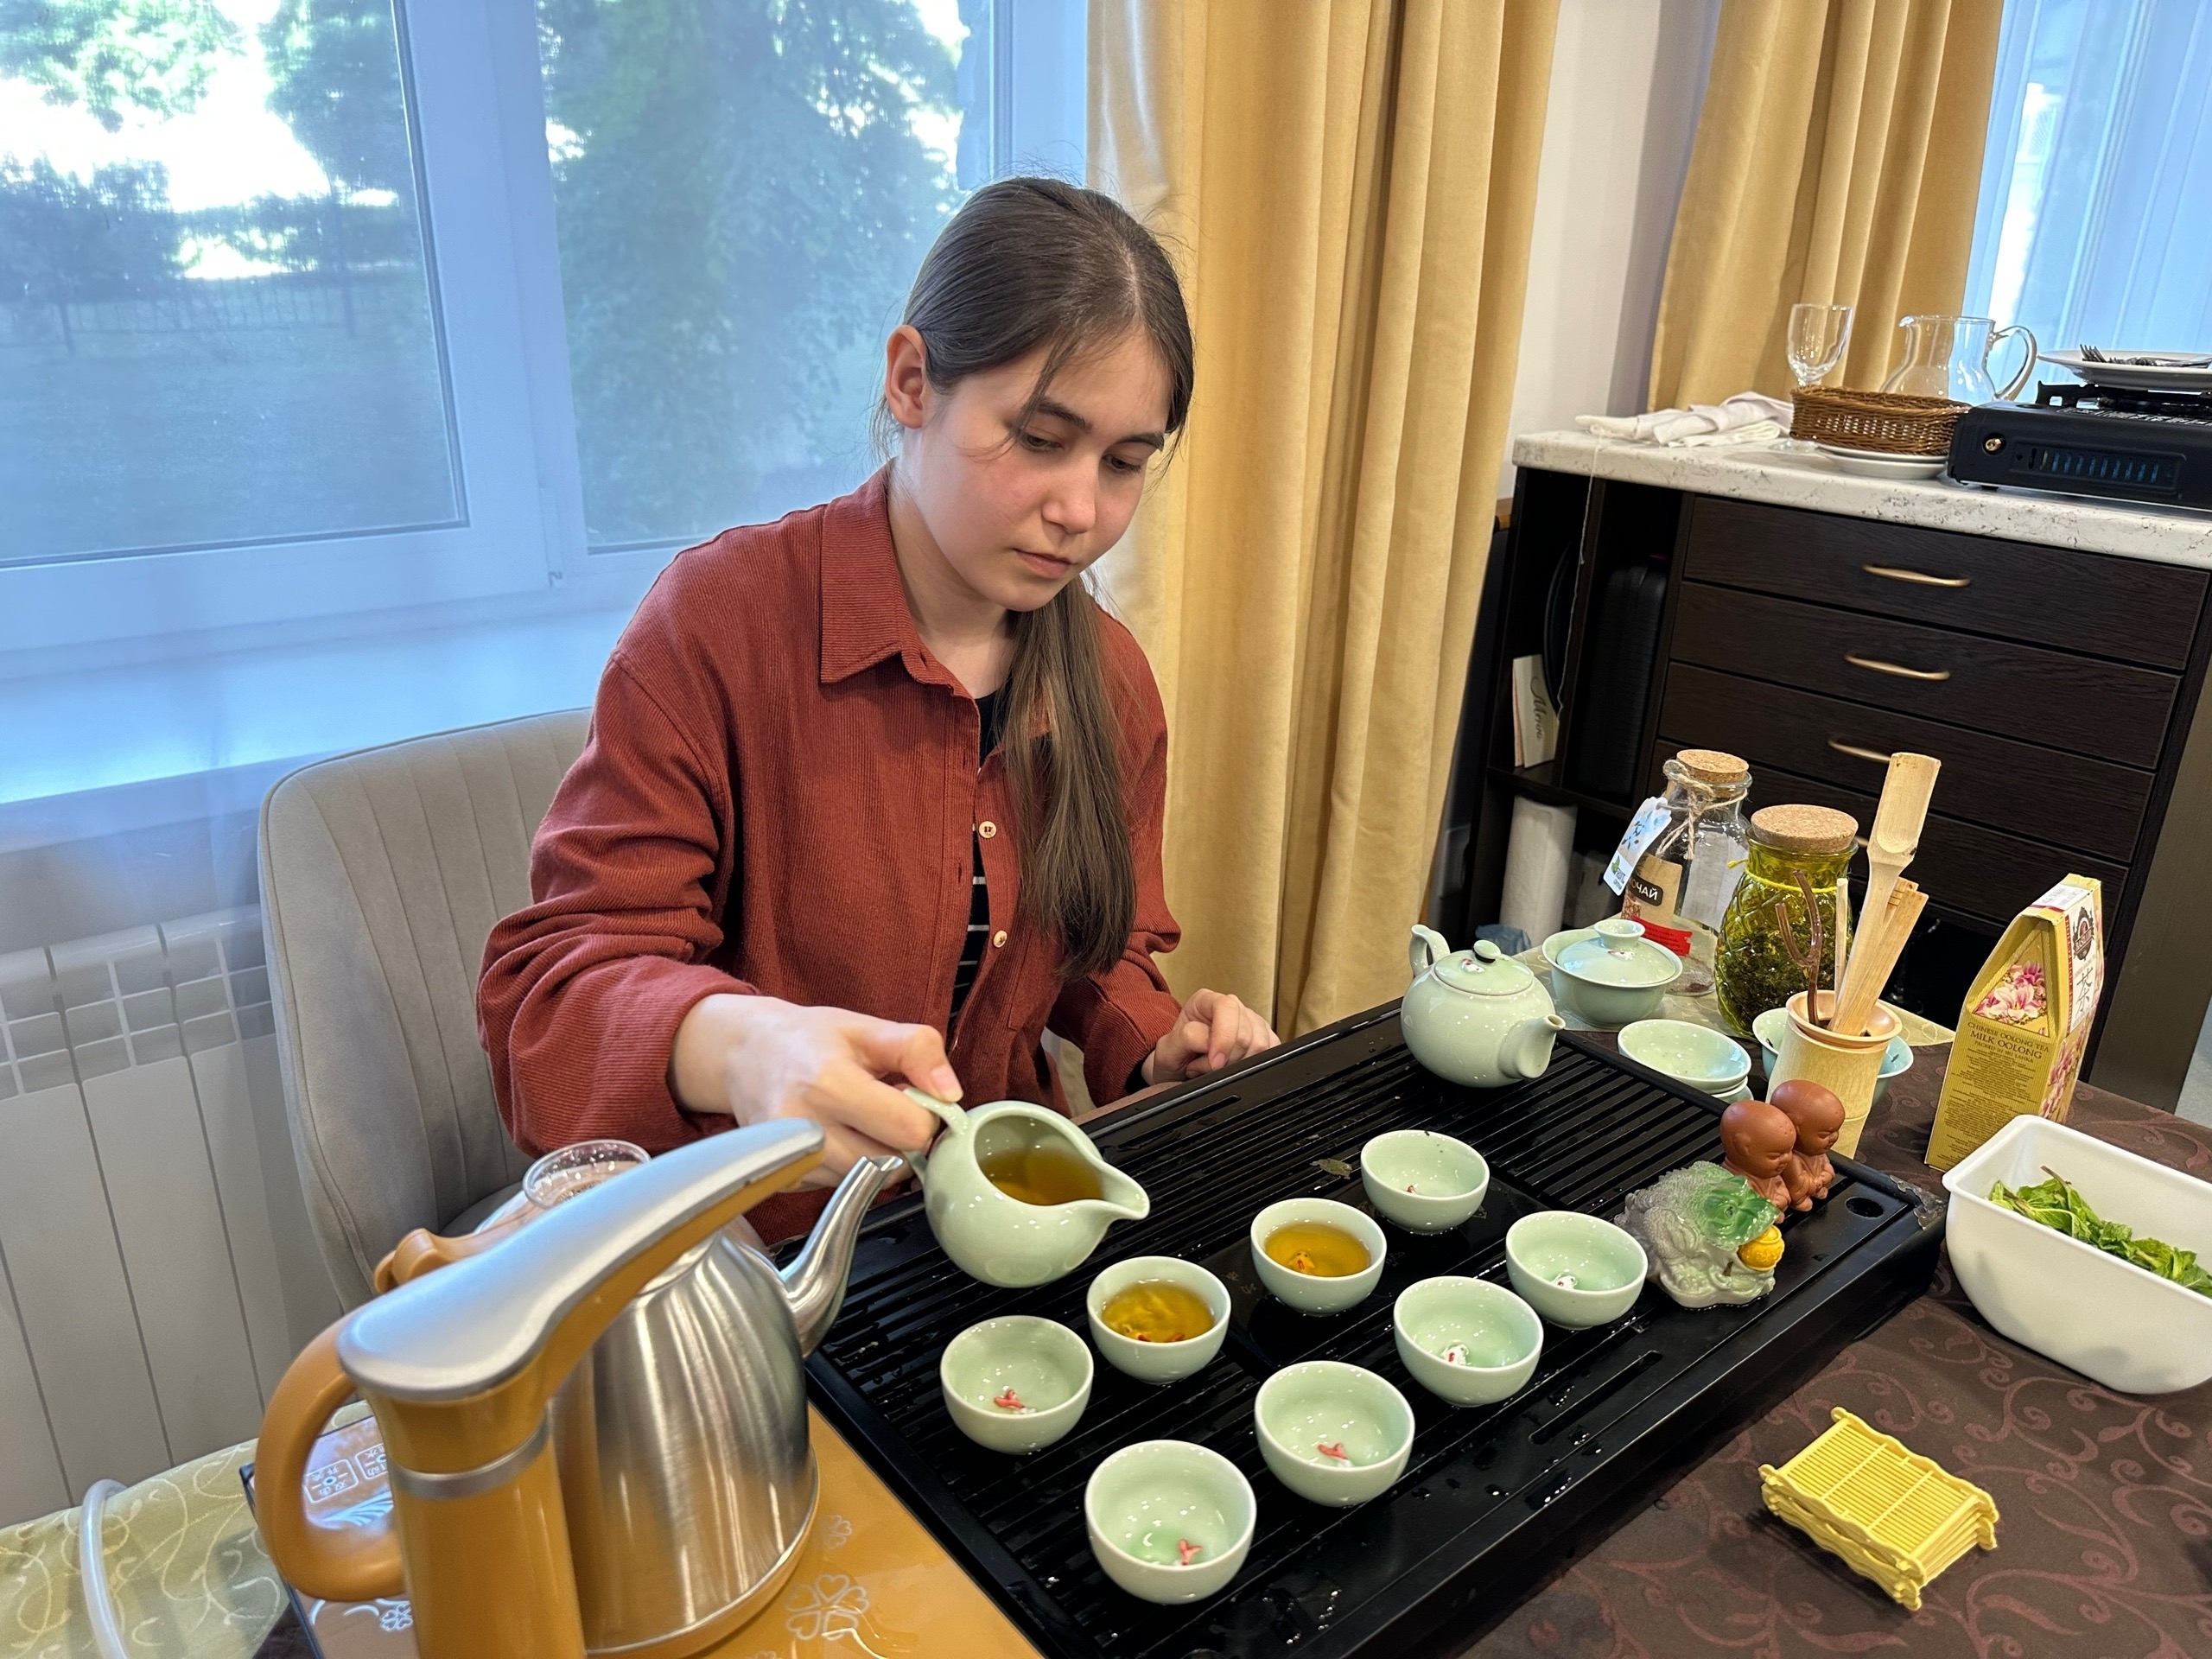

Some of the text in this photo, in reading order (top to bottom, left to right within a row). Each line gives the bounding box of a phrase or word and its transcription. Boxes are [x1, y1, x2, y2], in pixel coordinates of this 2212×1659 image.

[1967, 1021, 2050, 1052] CHINESE OOLONG TEA
[1970, 1031, 2042, 1059] MILK OOLONG
[1974, 1040, 1995, 1051] PACKED
[2014, 1053, 2034, 1063] LANKA
